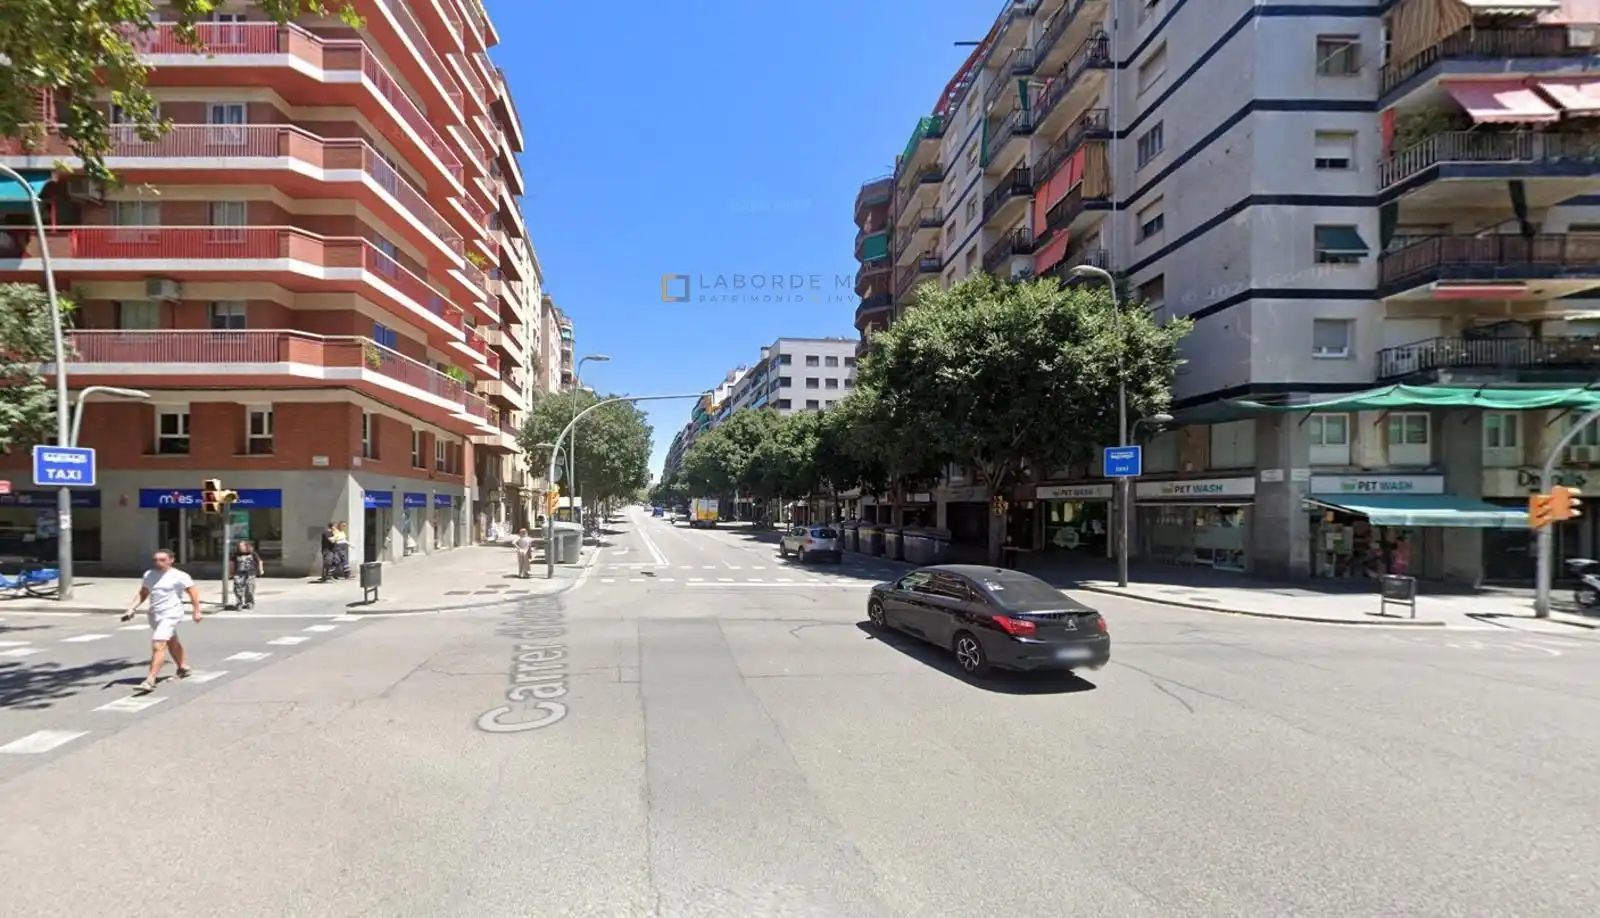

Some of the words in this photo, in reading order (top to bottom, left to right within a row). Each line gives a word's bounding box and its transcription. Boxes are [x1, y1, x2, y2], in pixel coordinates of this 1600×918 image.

[45, 468, 82, 480] TAXI
[1174, 485, 1190, 494] PET
[1192, 483, 1223, 493] WASH
[1358, 481, 1377, 491] PET
[1379, 481, 1413, 491] WASH
[159, 491, 193, 505] mies
